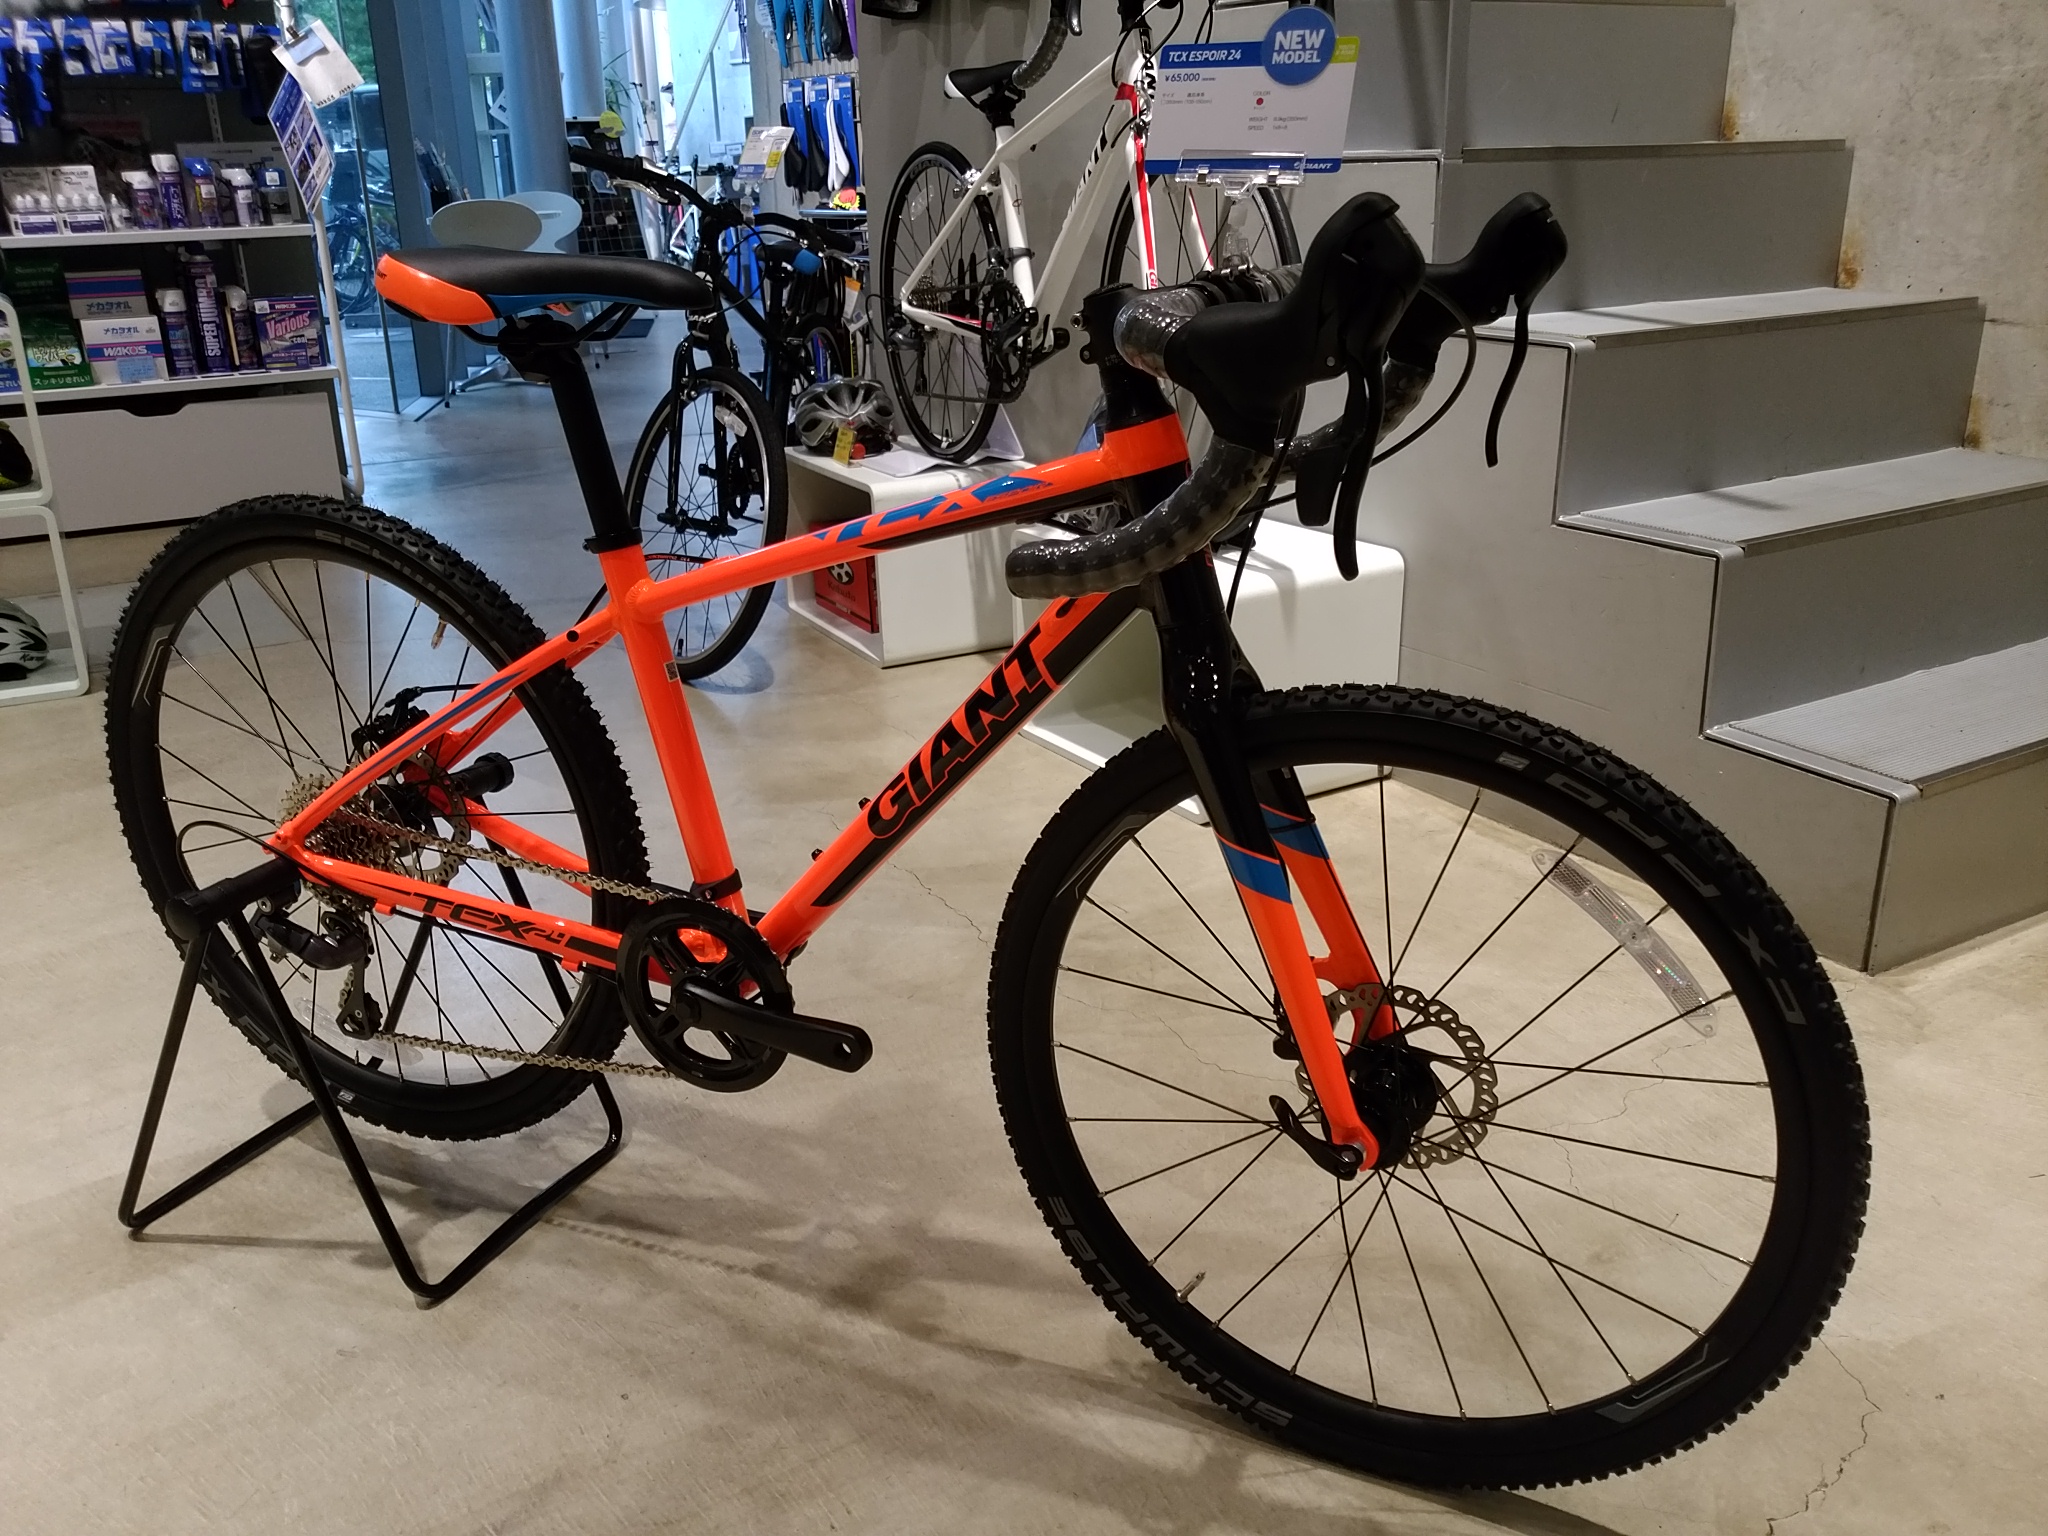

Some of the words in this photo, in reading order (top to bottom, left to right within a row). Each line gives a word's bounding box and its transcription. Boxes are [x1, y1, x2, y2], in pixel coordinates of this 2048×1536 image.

[1274, 28, 1326, 50] NEW
[1167, 51, 1187, 63] TCX
[1188, 50, 1226, 62] ESPOIR
[1227, 49, 1242, 61] 24
[1272, 50, 1322, 65] MODEL
[1165, 73, 1200, 84] ¥65,000
[1300, 162, 1333, 170] GIANT
[86, 301, 132, 311] メカタオル
[103, 326, 140, 335] メカタオル
[266, 312, 310, 339] Various
[202, 323, 222, 357] SUPER
[866, 626, 1045, 839] GIANT
[1047, 1195, 1294, 1429] SCHWALBE
